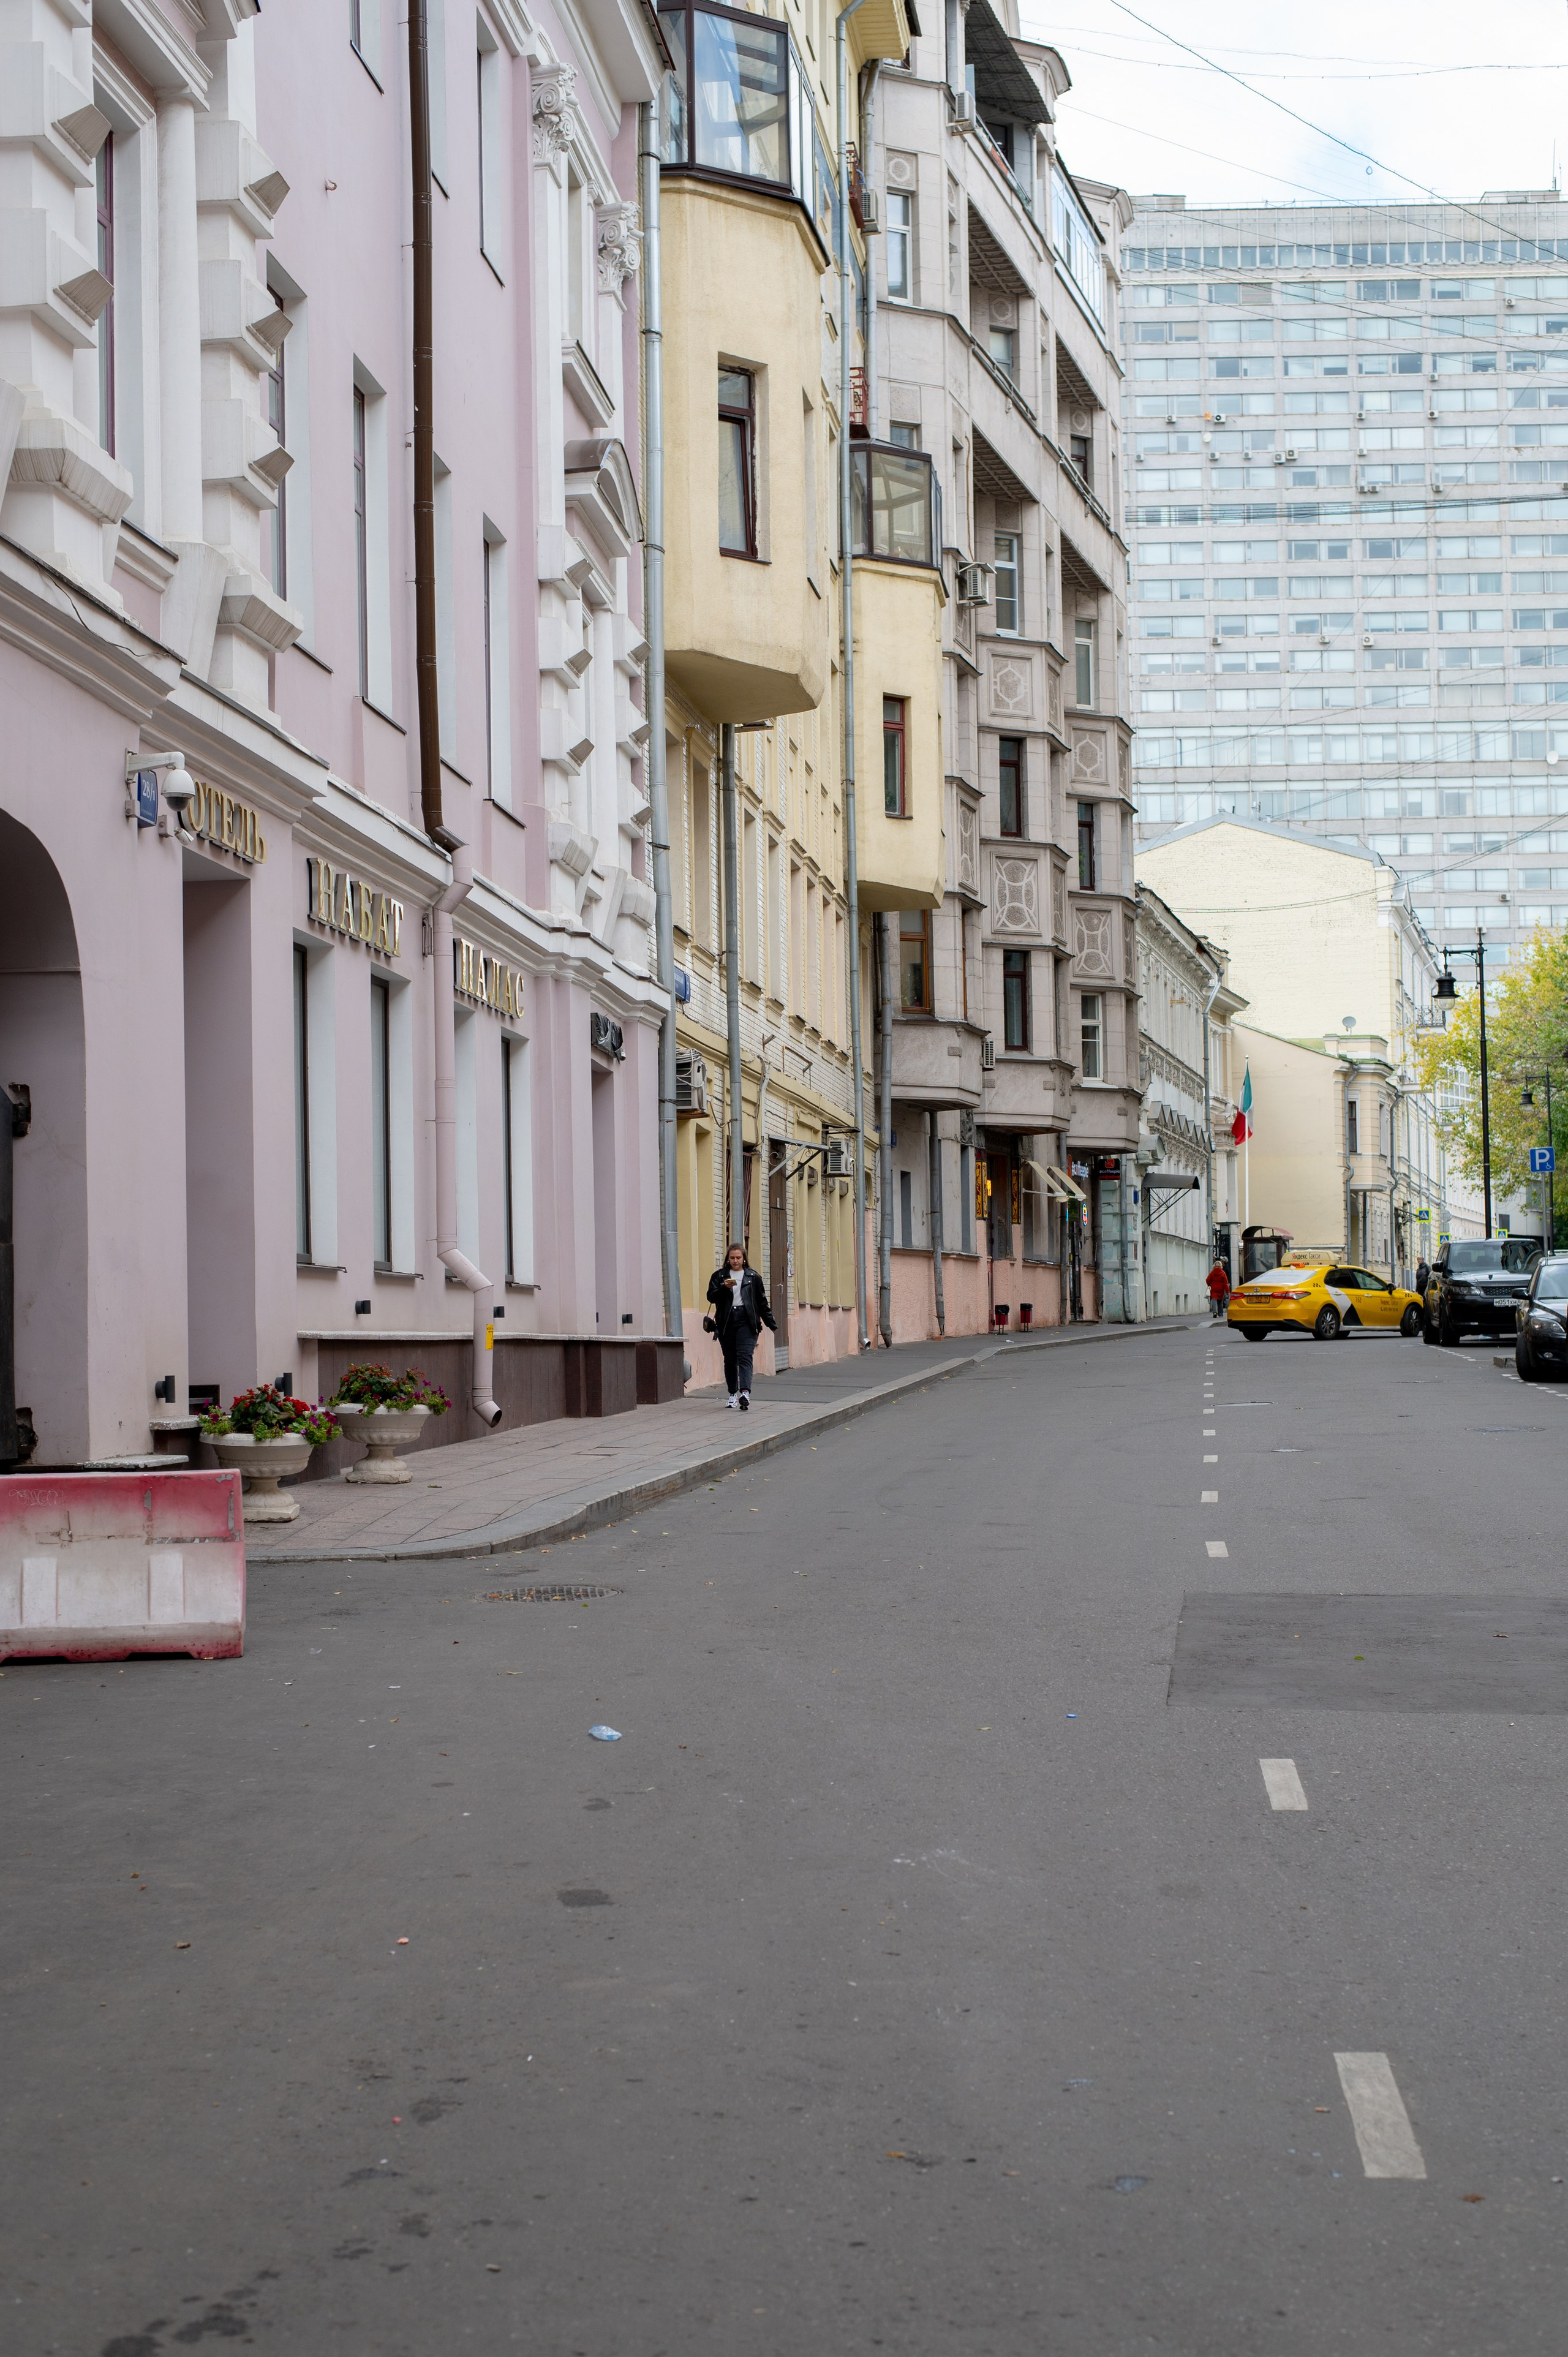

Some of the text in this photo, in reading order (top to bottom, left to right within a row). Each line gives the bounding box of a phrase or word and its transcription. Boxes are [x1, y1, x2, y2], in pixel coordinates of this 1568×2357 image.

[142, 779, 156, 802] 28/1
[183, 778, 268, 864] ОТЕЛЬ
[310, 858, 404, 957] НАБАТ
[456, 938, 524, 1019] ПАЛАС
[1536, 1149, 1550, 1170] P
